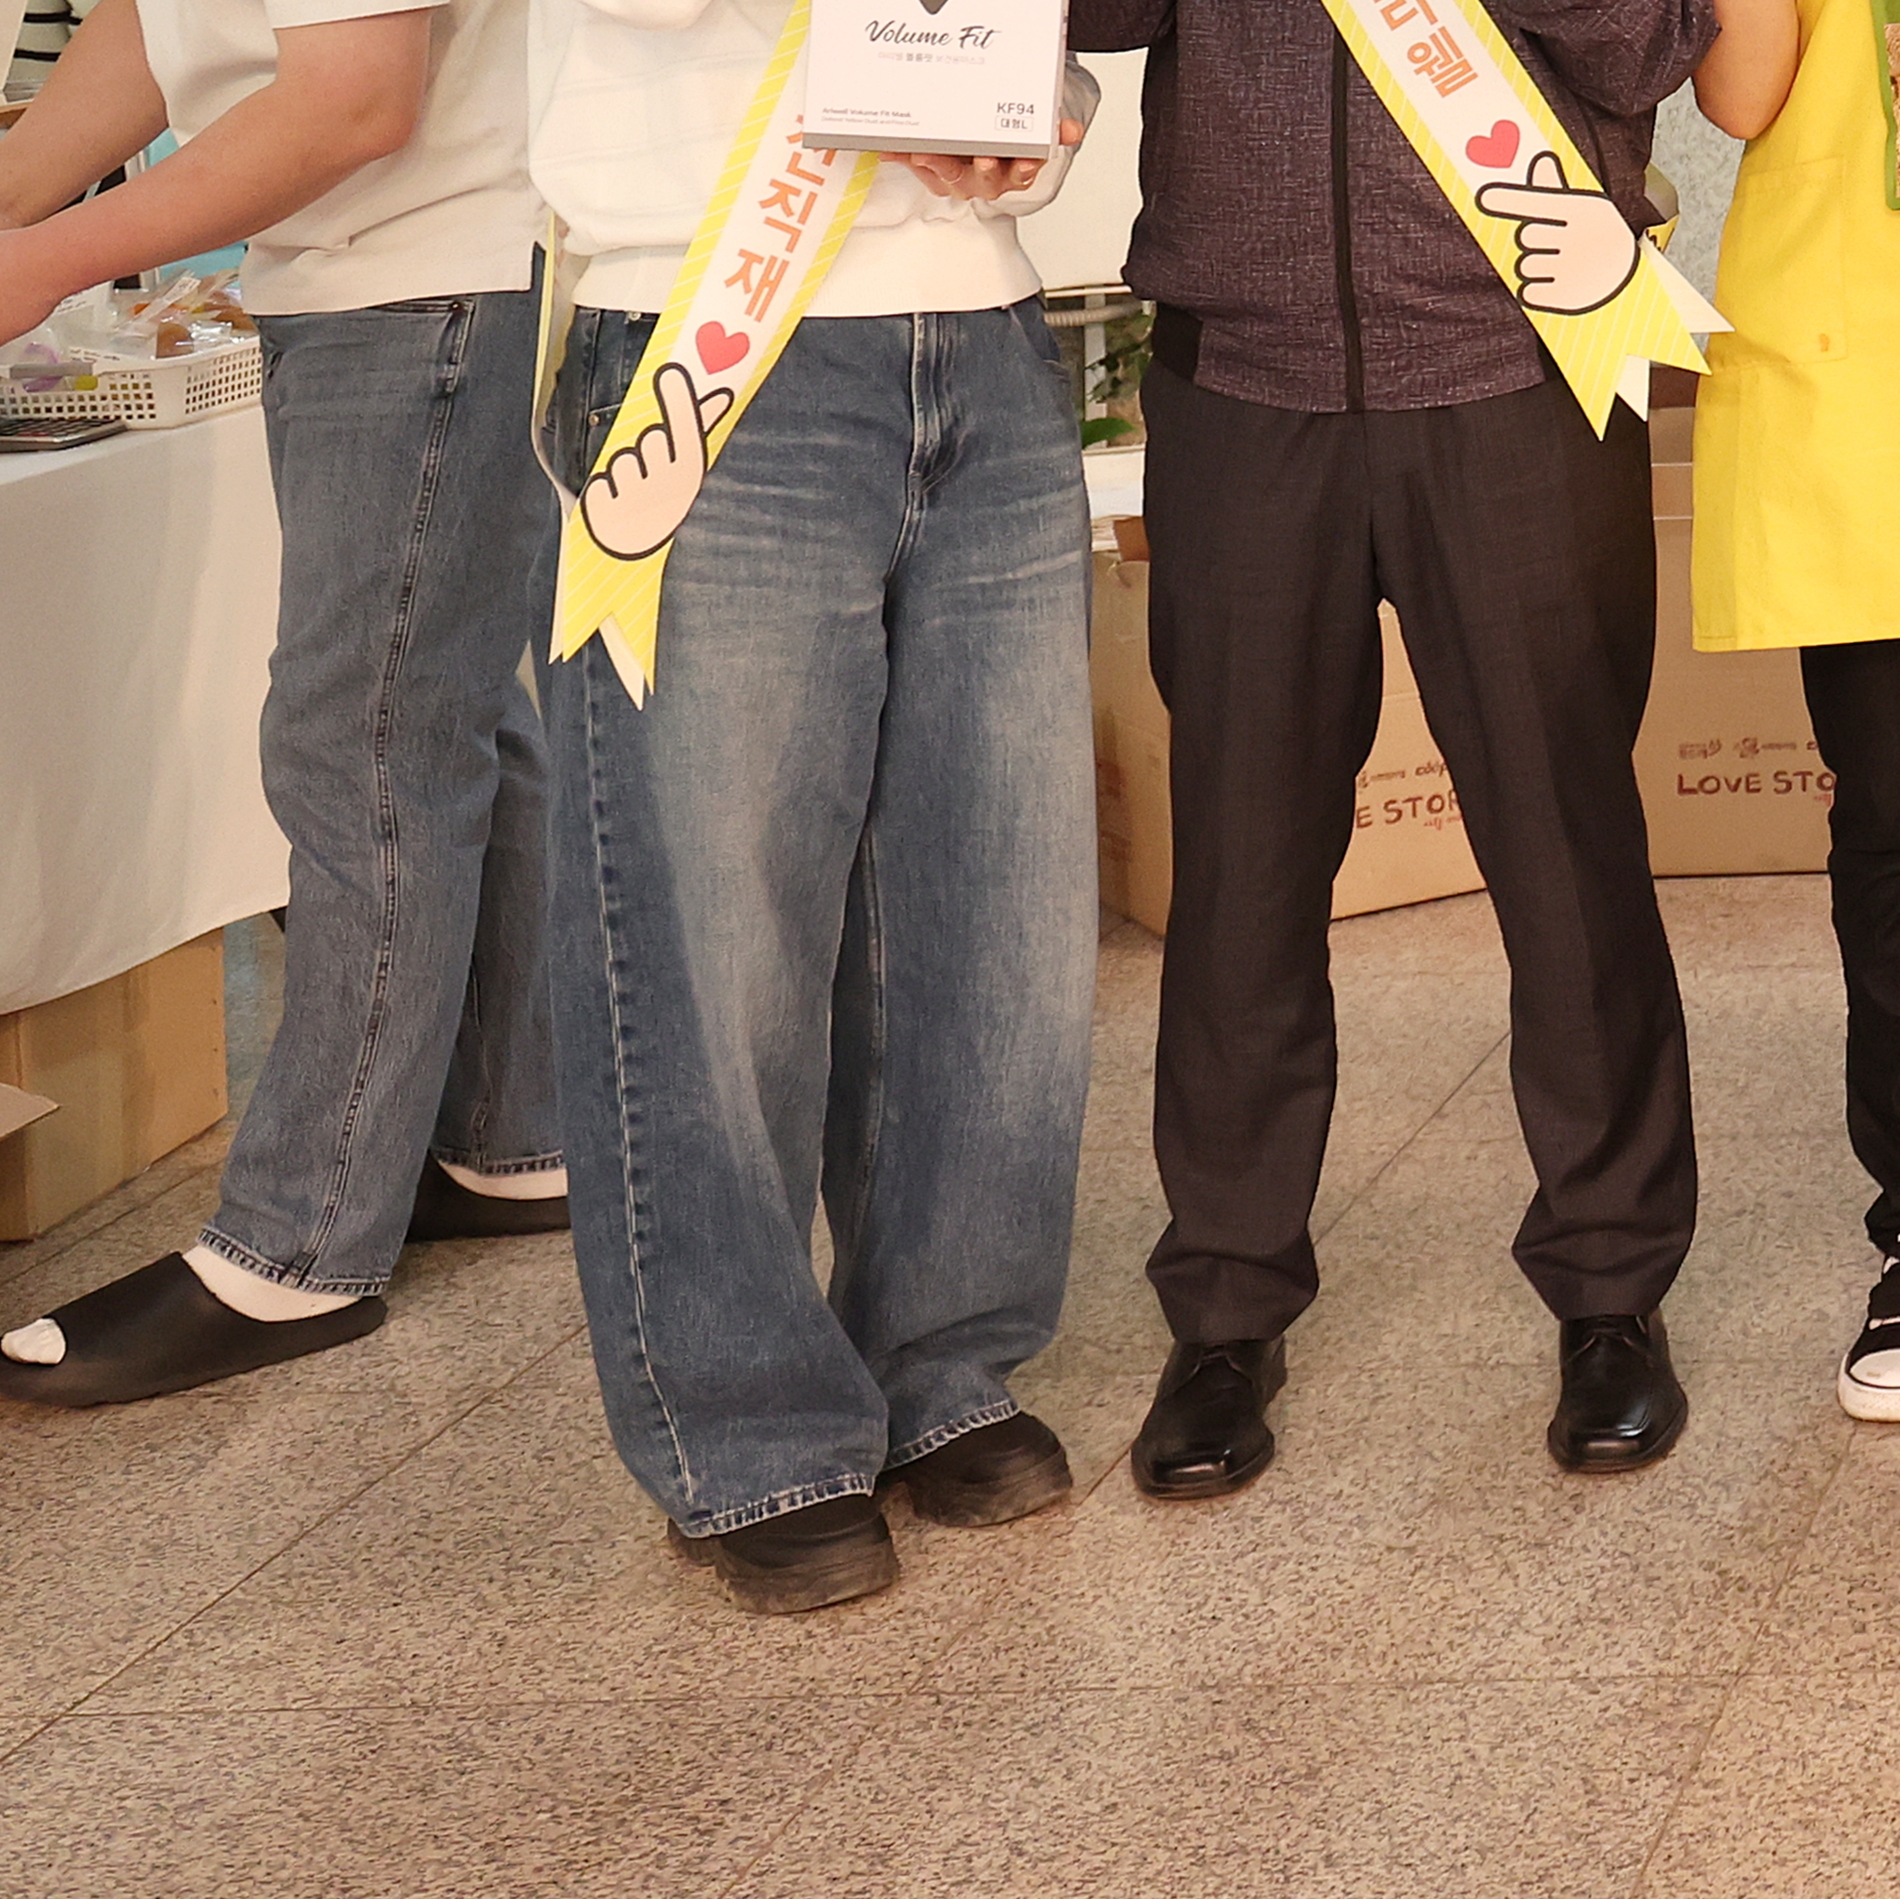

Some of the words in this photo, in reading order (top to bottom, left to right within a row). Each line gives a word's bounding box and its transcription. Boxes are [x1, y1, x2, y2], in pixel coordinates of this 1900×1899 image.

[864, 19, 952, 46] Volume
[958, 25, 1002, 50] Fit
[996, 102, 1035, 116] KF94
[1677, 772, 1763, 796] LOVE
